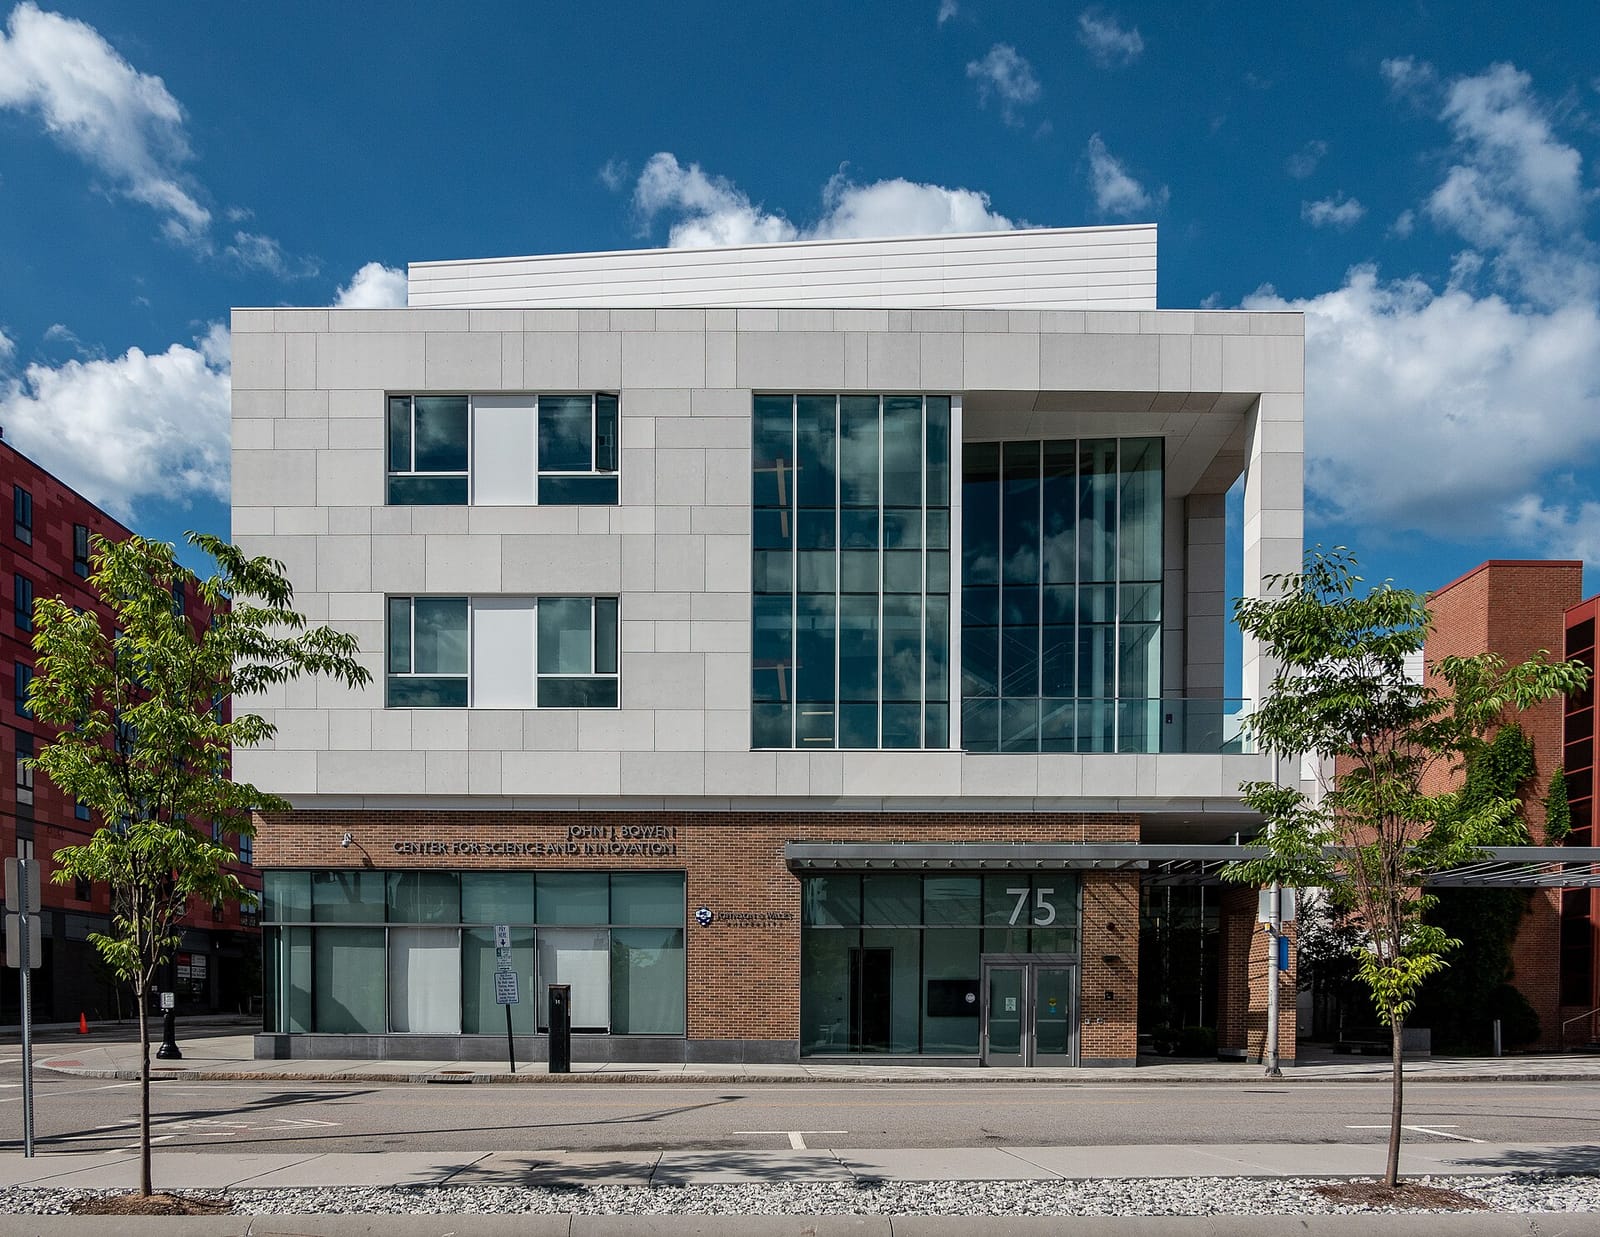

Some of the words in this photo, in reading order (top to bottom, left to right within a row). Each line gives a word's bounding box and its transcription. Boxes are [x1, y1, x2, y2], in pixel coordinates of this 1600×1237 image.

[567, 825, 605, 840] JOHN
[621, 825, 675, 838] BOWEN
[393, 841, 449, 854] CENTER
[452, 841, 481, 854] FOR
[483, 841, 545, 855] SCIENCE
[546, 842, 579, 855] AND
[583, 842, 676, 855] INNOVATION
[1006, 888, 1056, 926] 75
